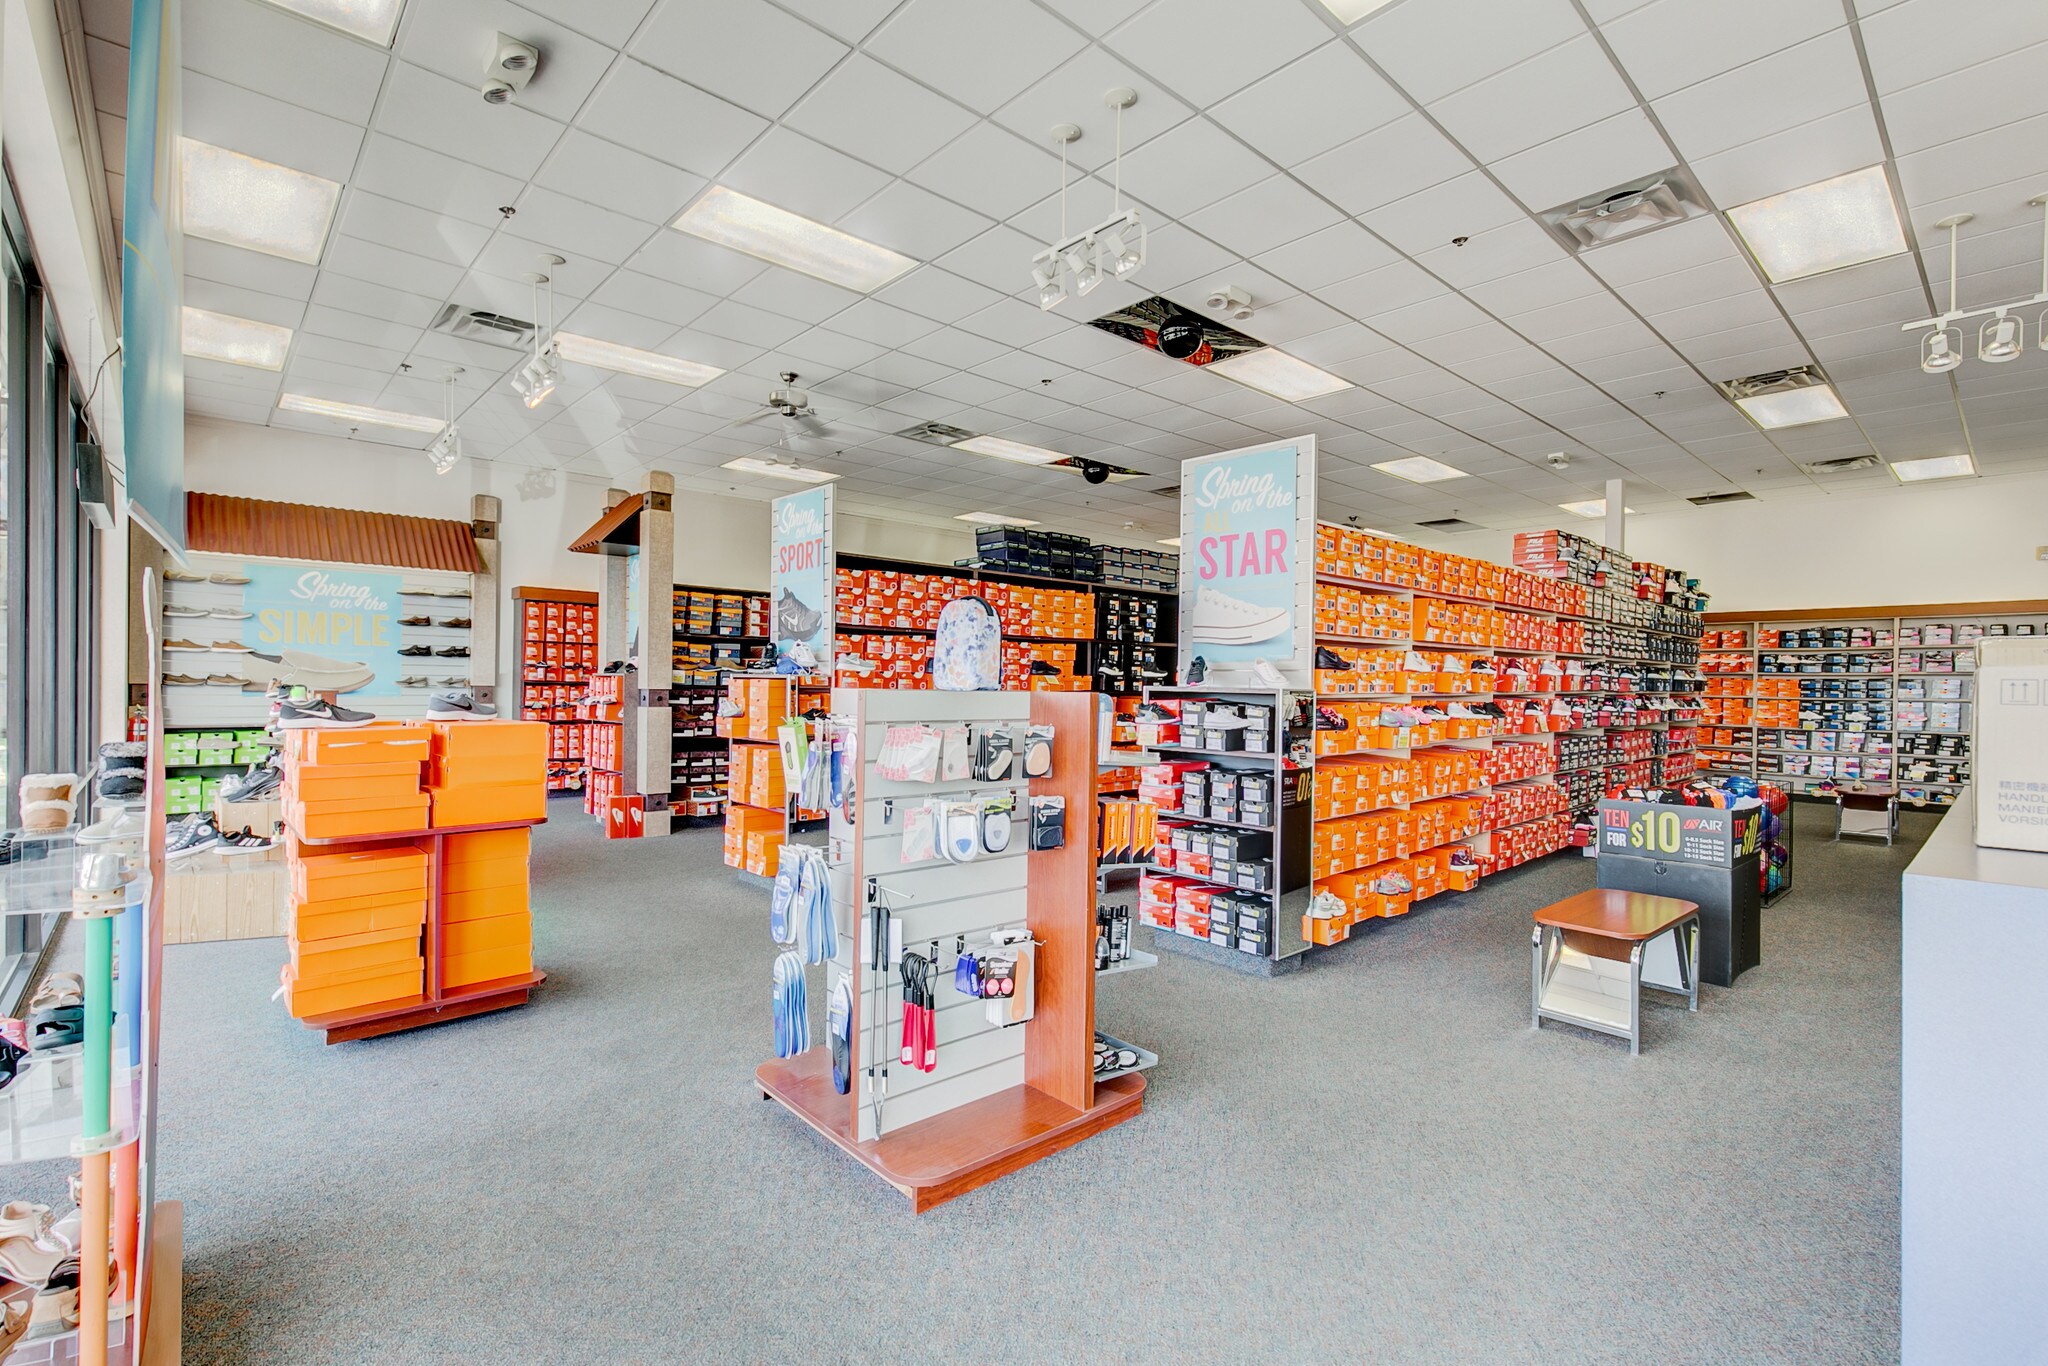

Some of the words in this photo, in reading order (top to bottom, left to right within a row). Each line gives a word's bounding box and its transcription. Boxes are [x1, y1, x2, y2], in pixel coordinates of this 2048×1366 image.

[1195, 466, 1274, 509] Spring
[1232, 498, 1252, 513] on
[1267, 487, 1293, 508] the
[779, 502, 816, 535] Spring
[1204, 512, 1232, 532] ALL
[779, 537, 822, 574] SPORT
[1199, 528, 1289, 580] STAR
[289, 571, 372, 607] Spring
[329, 599, 352, 609] on
[364, 596, 389, 611] the
[258, 608, 391, 647] SIMPLE
[1603, 808, 1630, 828] TEN
[1998, 803, 2048, 815] MANIE
[1606, 831, 1627, 847] FOR
[1630, 810, 1681, 854] $10
[1699, 819, 1723, 832] AIR
